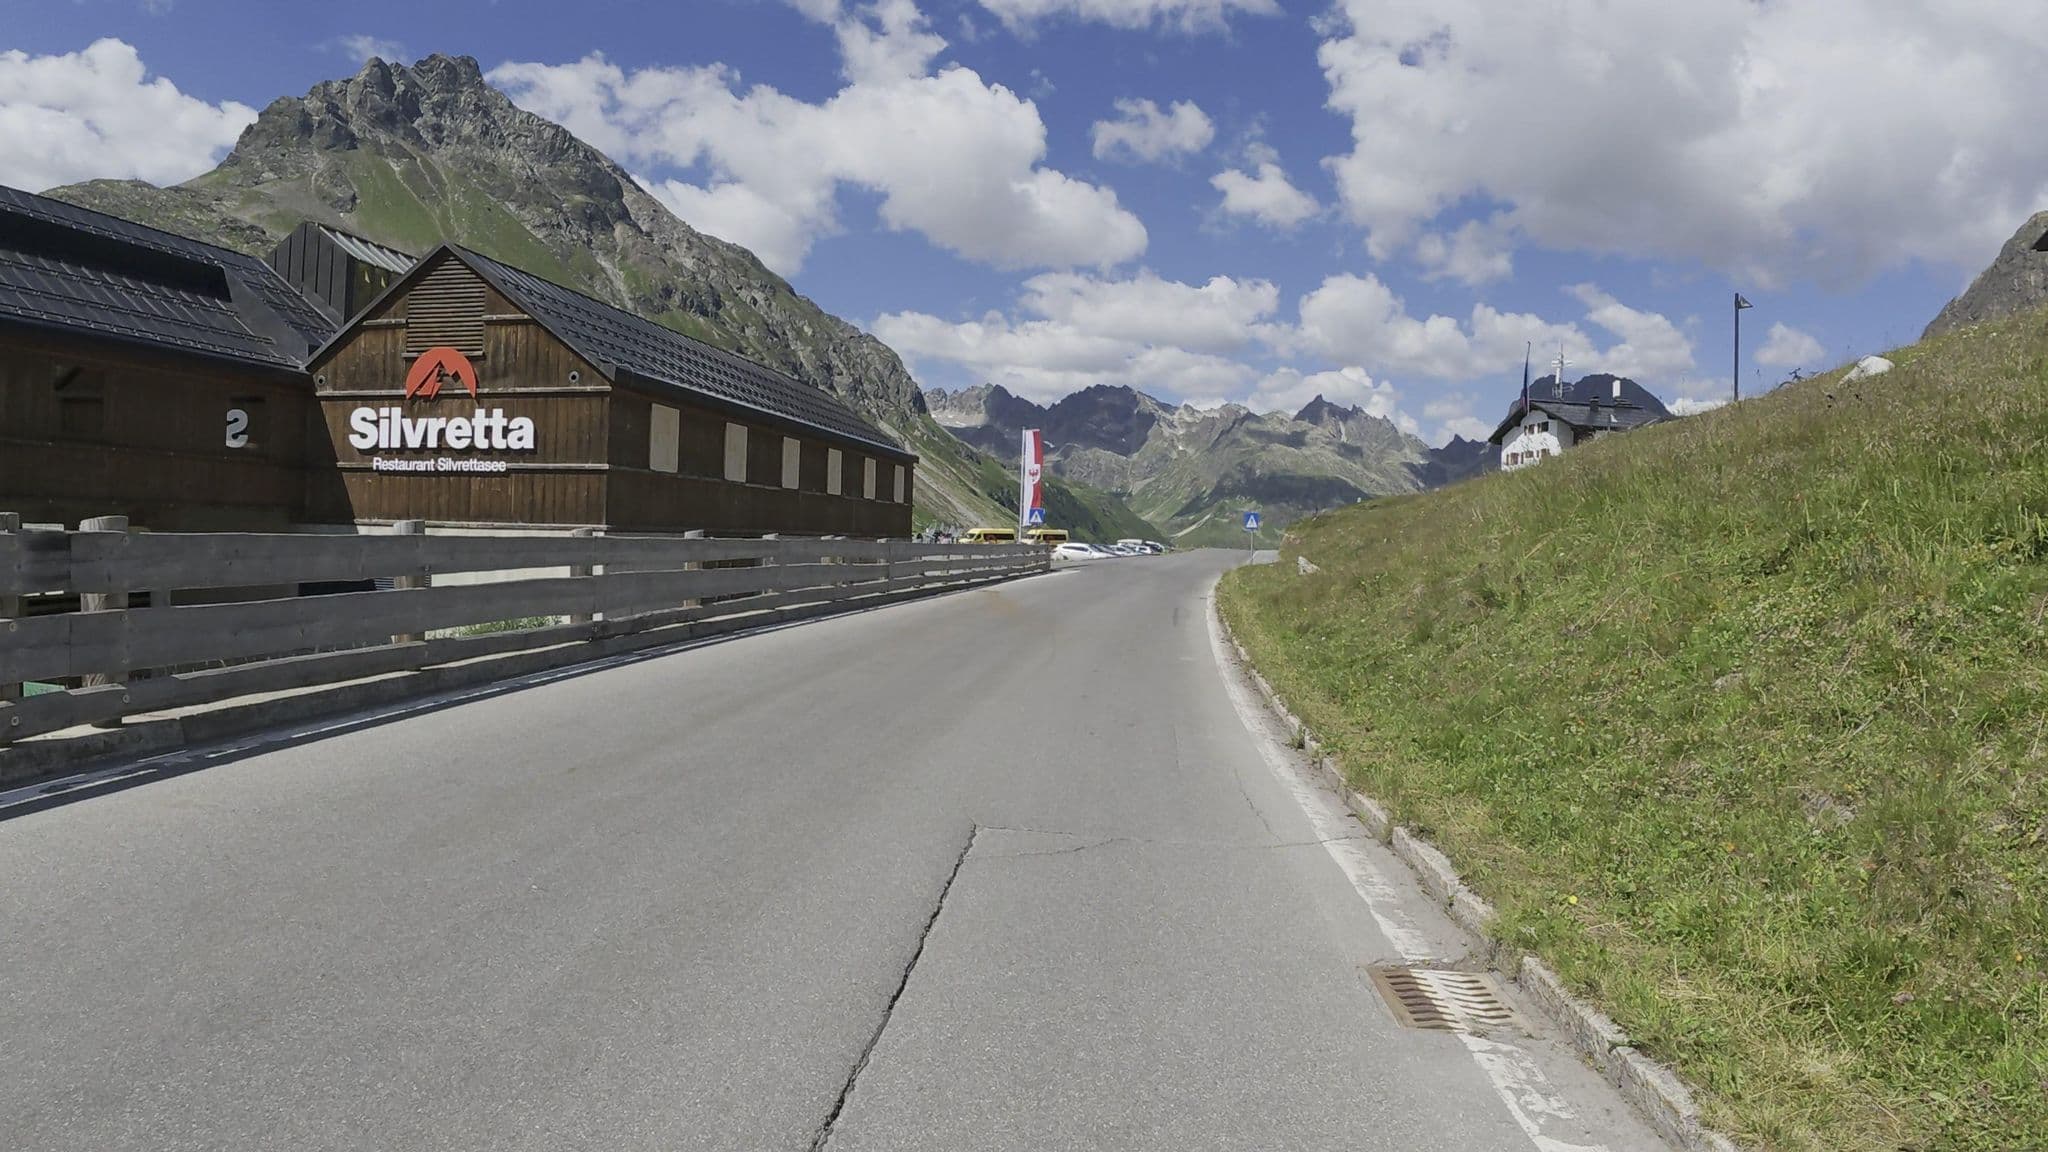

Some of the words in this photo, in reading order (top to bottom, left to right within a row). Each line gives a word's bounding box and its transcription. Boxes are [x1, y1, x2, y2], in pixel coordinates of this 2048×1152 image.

[348, 406, 535, 450] Silvretta
[372, 456, 435, 472] Restaurant
[437, 457, 507, 472] Silvrettasee
